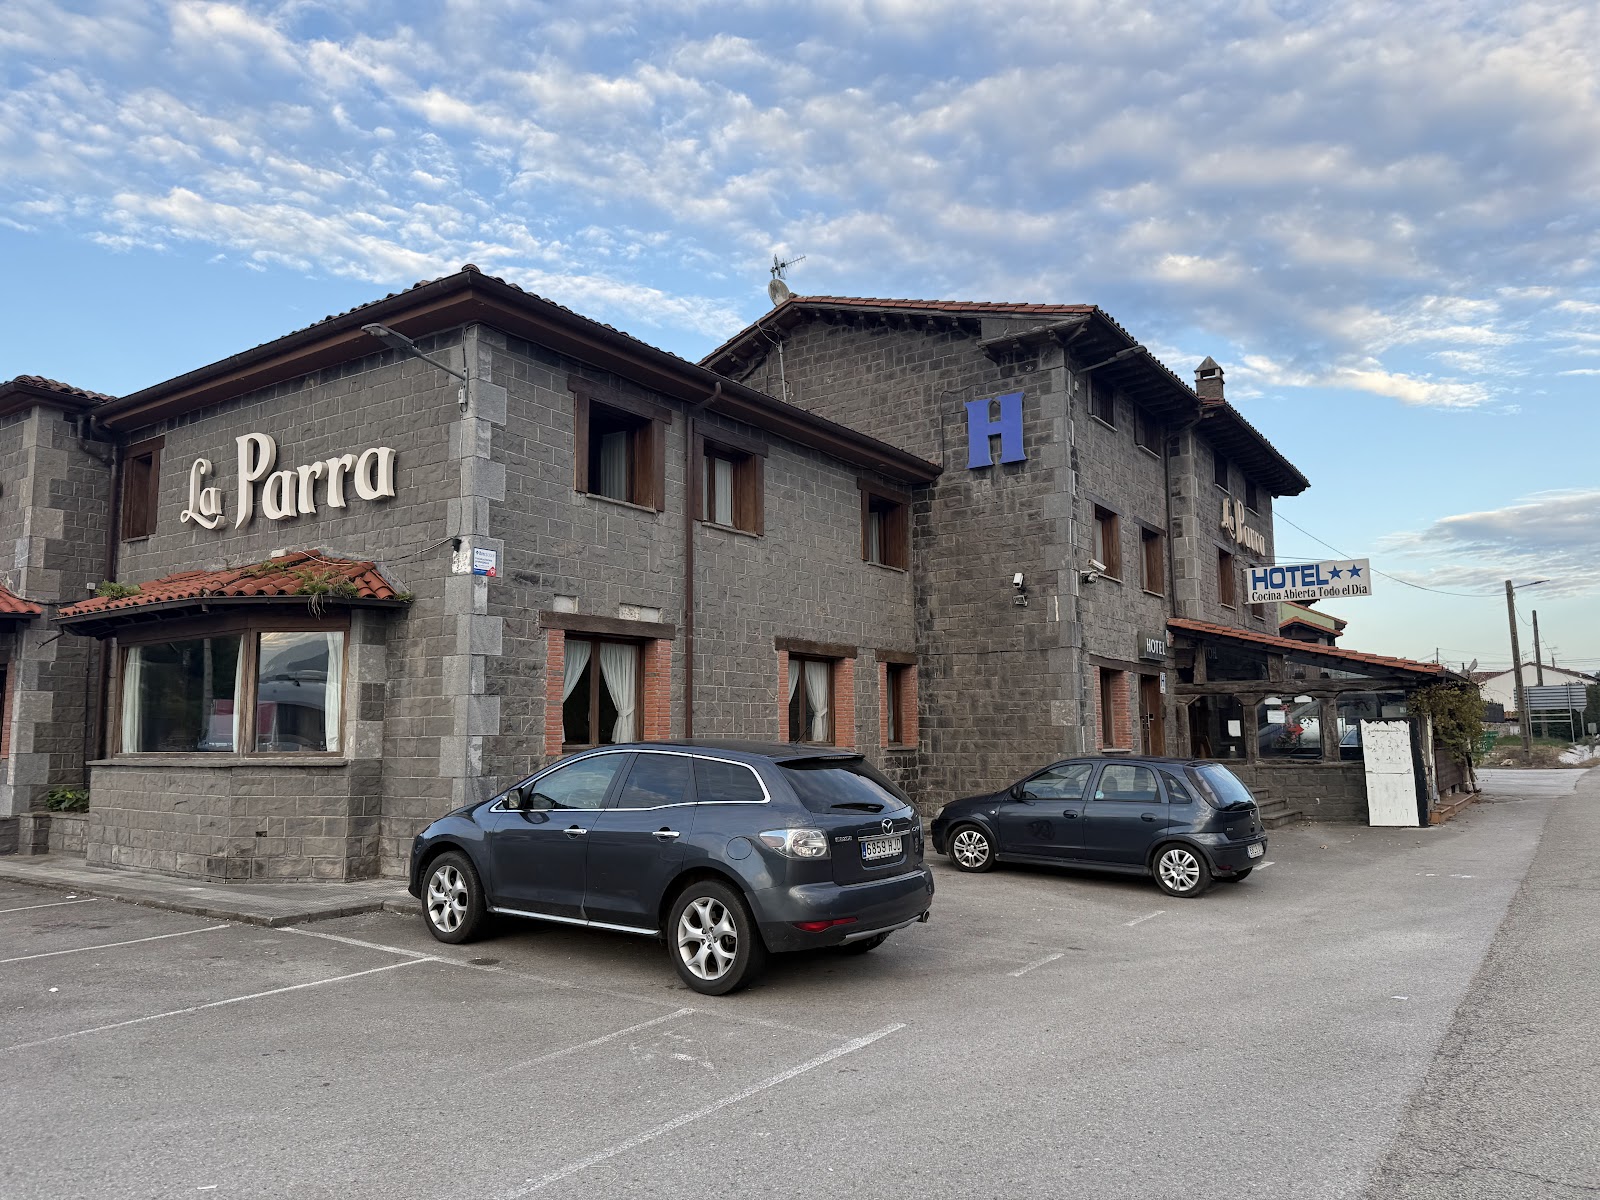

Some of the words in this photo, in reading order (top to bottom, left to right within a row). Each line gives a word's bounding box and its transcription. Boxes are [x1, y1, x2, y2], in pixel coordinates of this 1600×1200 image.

[963, 392, 1027, 469] H
[180, 458, 225, 530] La
[235, 432, 397, 530] Parra
[1221, 498, 1236, 539] La
[1234, 499, 1265, 556] Parra
[1251, 564, 1329, 590] HOTEL
[1252, 591, 1281, 602] Cocina
[1284, 588, 1316, 599] Abierta
[1317, 586, 1340, 597] Todo
[1342, 584, 1350, 595] el
[1352, 583, 1368, 595] Día
[1146, 638, 1166, 655] HOTEL
[866, 840, 886, 855] 6859
